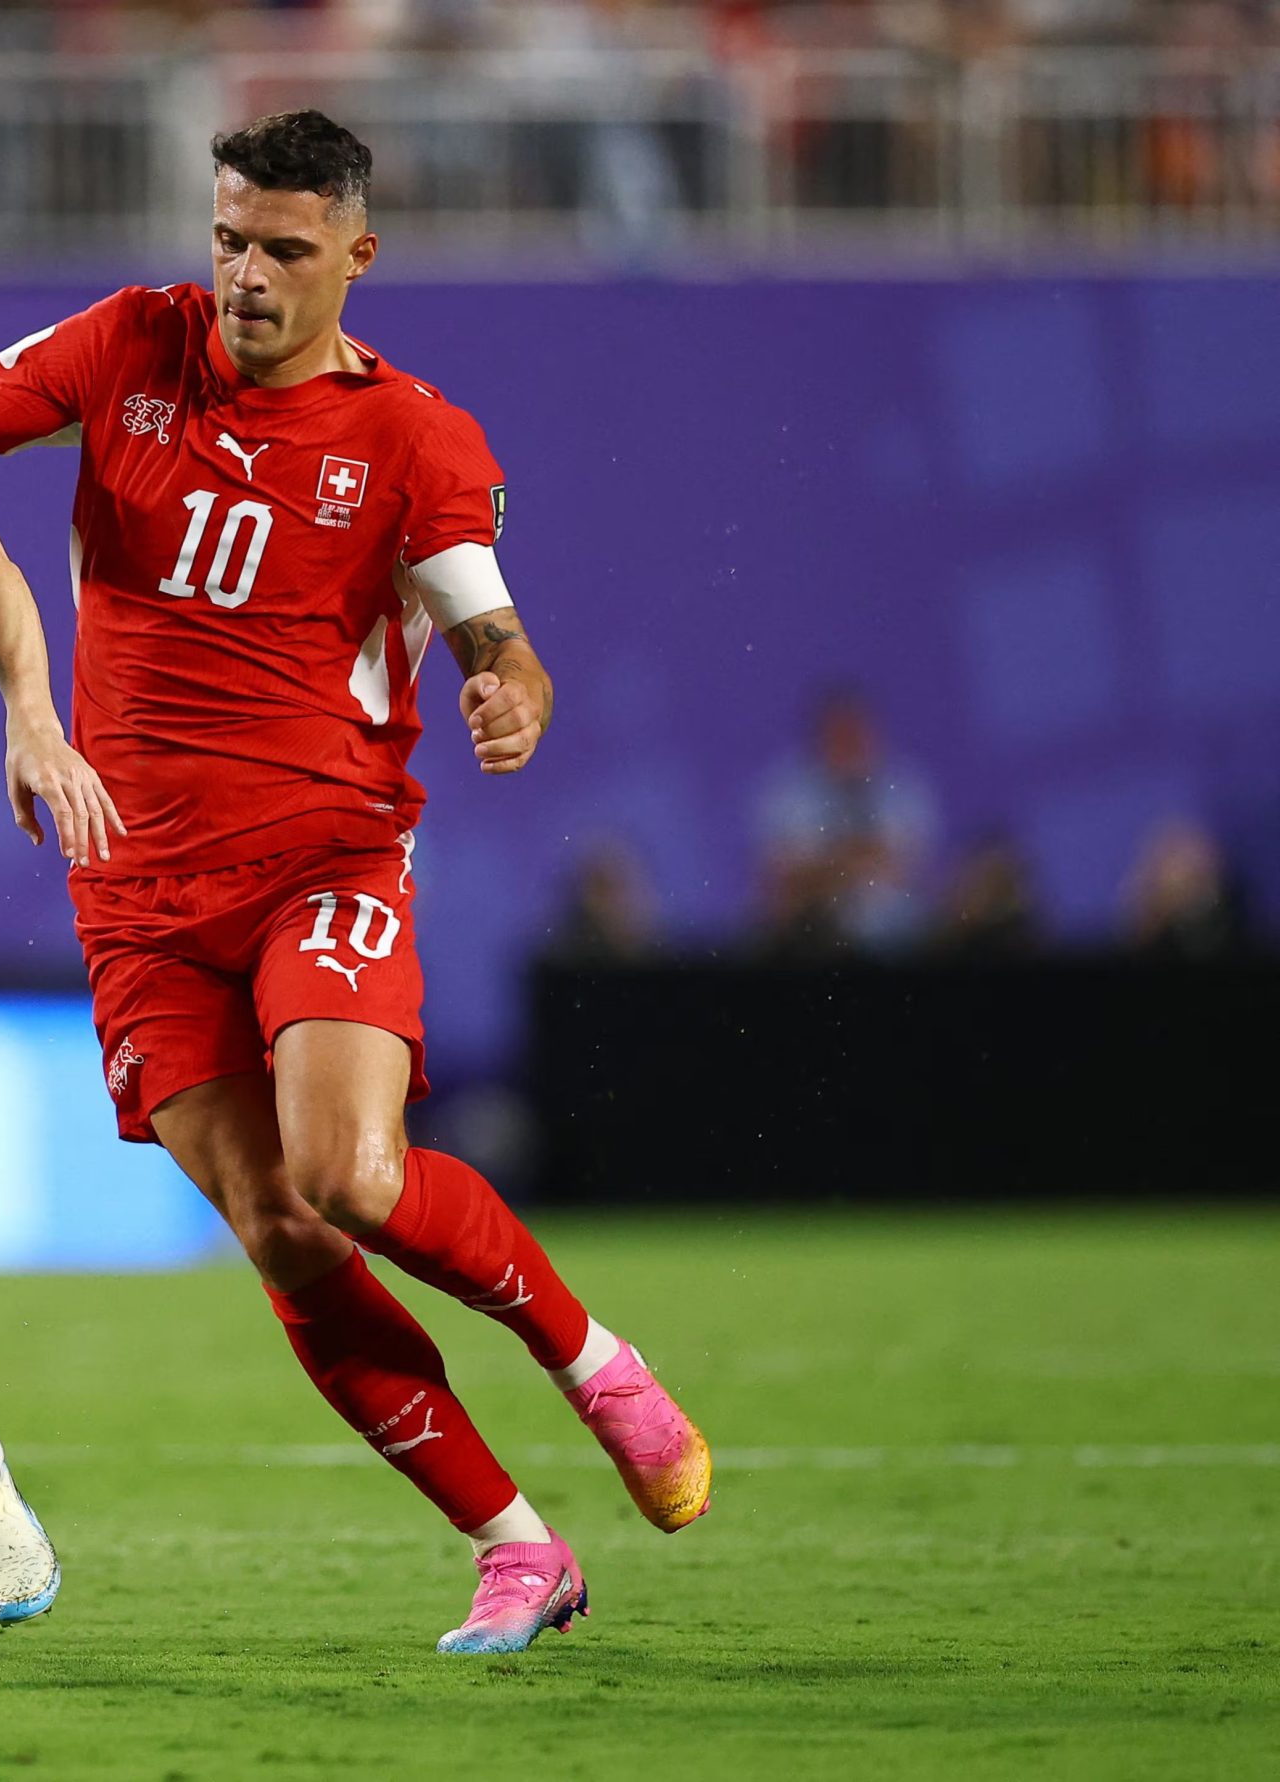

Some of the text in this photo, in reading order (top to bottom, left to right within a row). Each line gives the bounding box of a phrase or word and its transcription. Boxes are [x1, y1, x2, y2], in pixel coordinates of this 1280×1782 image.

[158, 489, 274, 610] 10
[337, 520, 352, 530] CITY
[299, 891, 401, 960] 10
